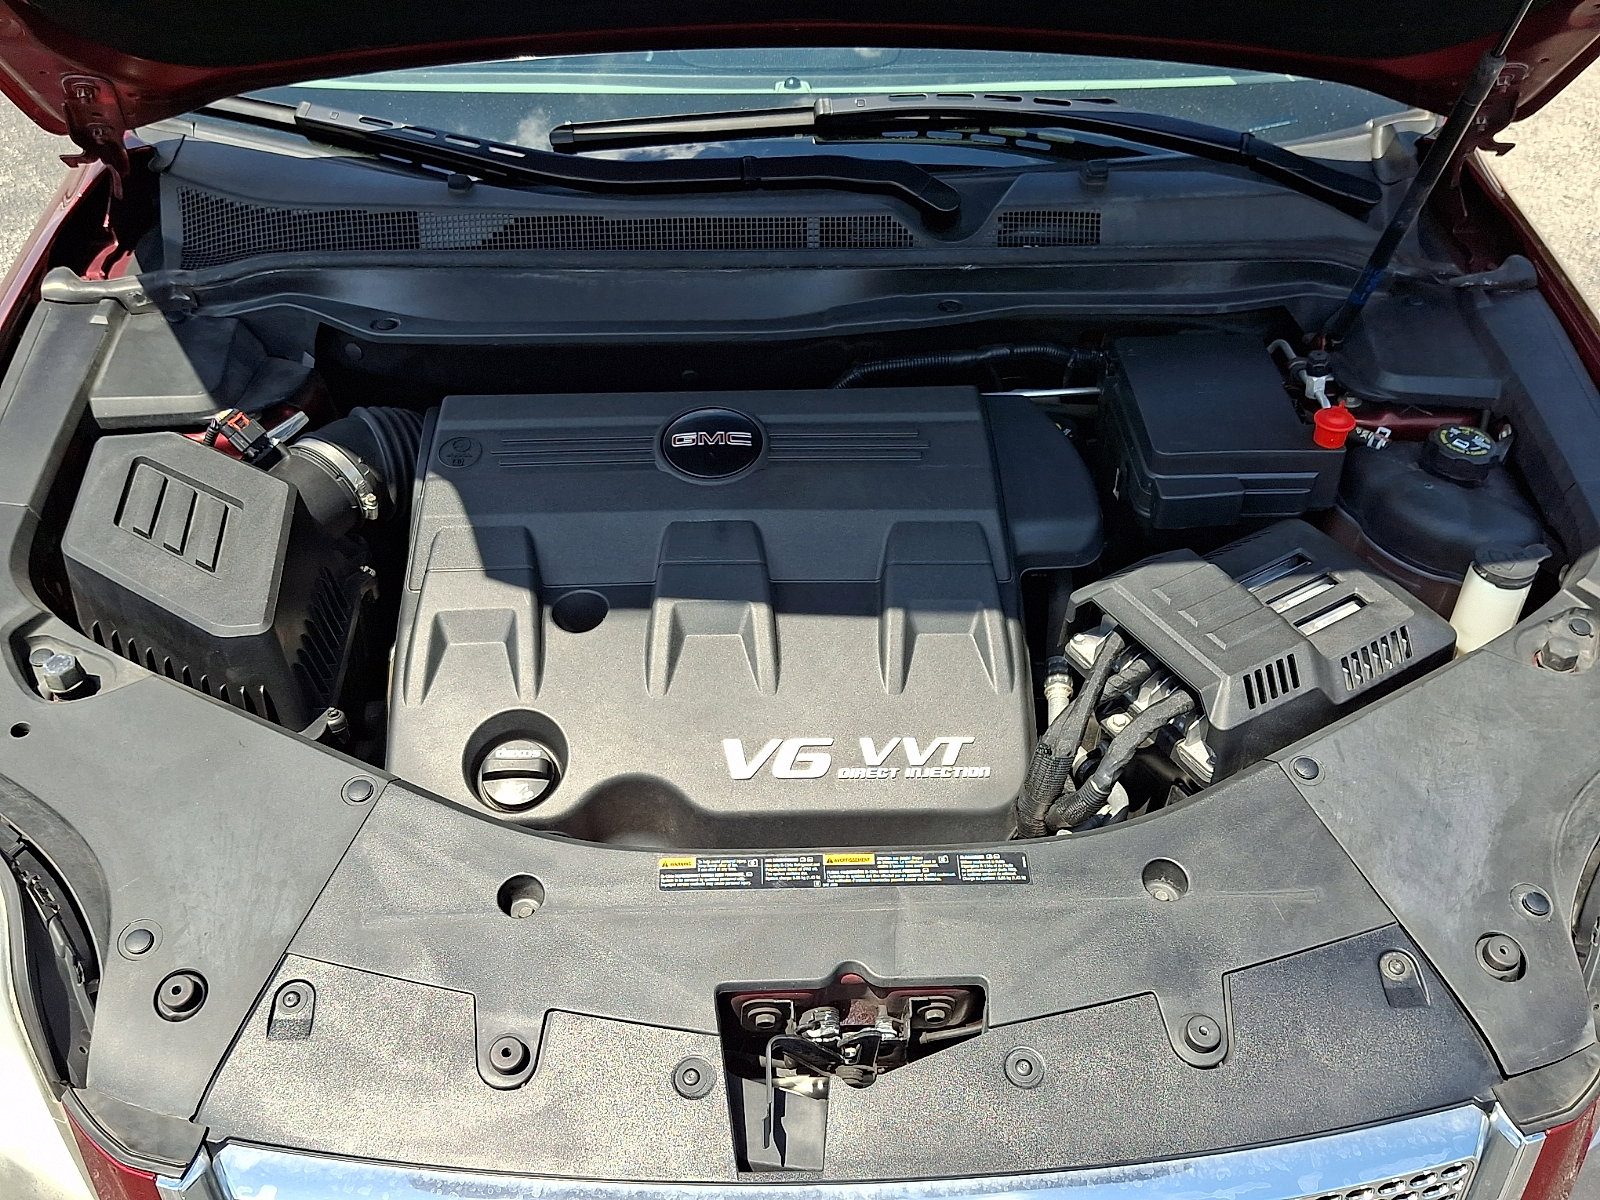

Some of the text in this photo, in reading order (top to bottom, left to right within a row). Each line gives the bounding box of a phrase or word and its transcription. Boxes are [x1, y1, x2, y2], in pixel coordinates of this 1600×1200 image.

[671, 431, 753, 448] GMC
[722, 737, 976, 781] V6 VVT
[837, 766, 991, 780] DIRECT INJECTION
